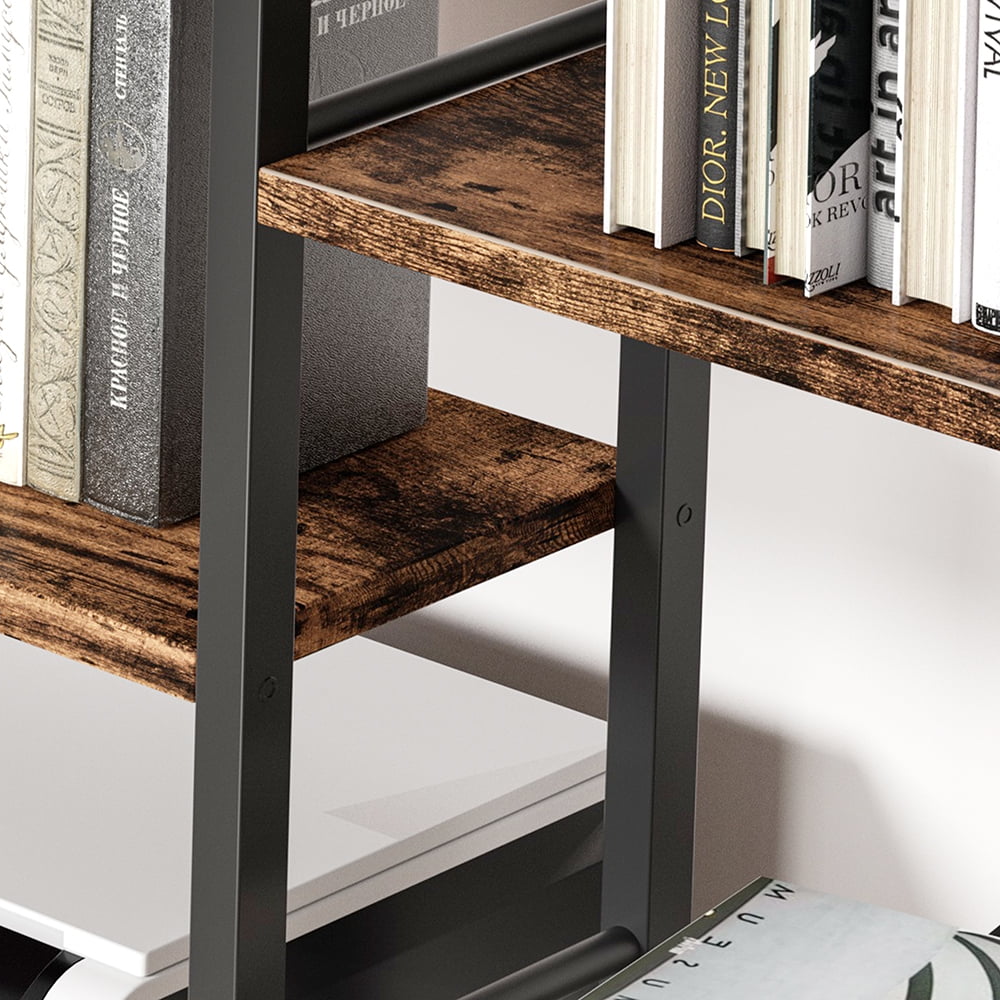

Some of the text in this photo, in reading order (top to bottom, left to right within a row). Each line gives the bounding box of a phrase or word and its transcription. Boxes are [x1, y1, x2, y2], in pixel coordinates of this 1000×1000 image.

[703, 32, 729, 119] NEW
[109, 14, 131, 411] КРАСНОЕ И ЧЕРНОЕ СТЕНДАЛЬ
[702, 129, 728, 225] DIOR.
